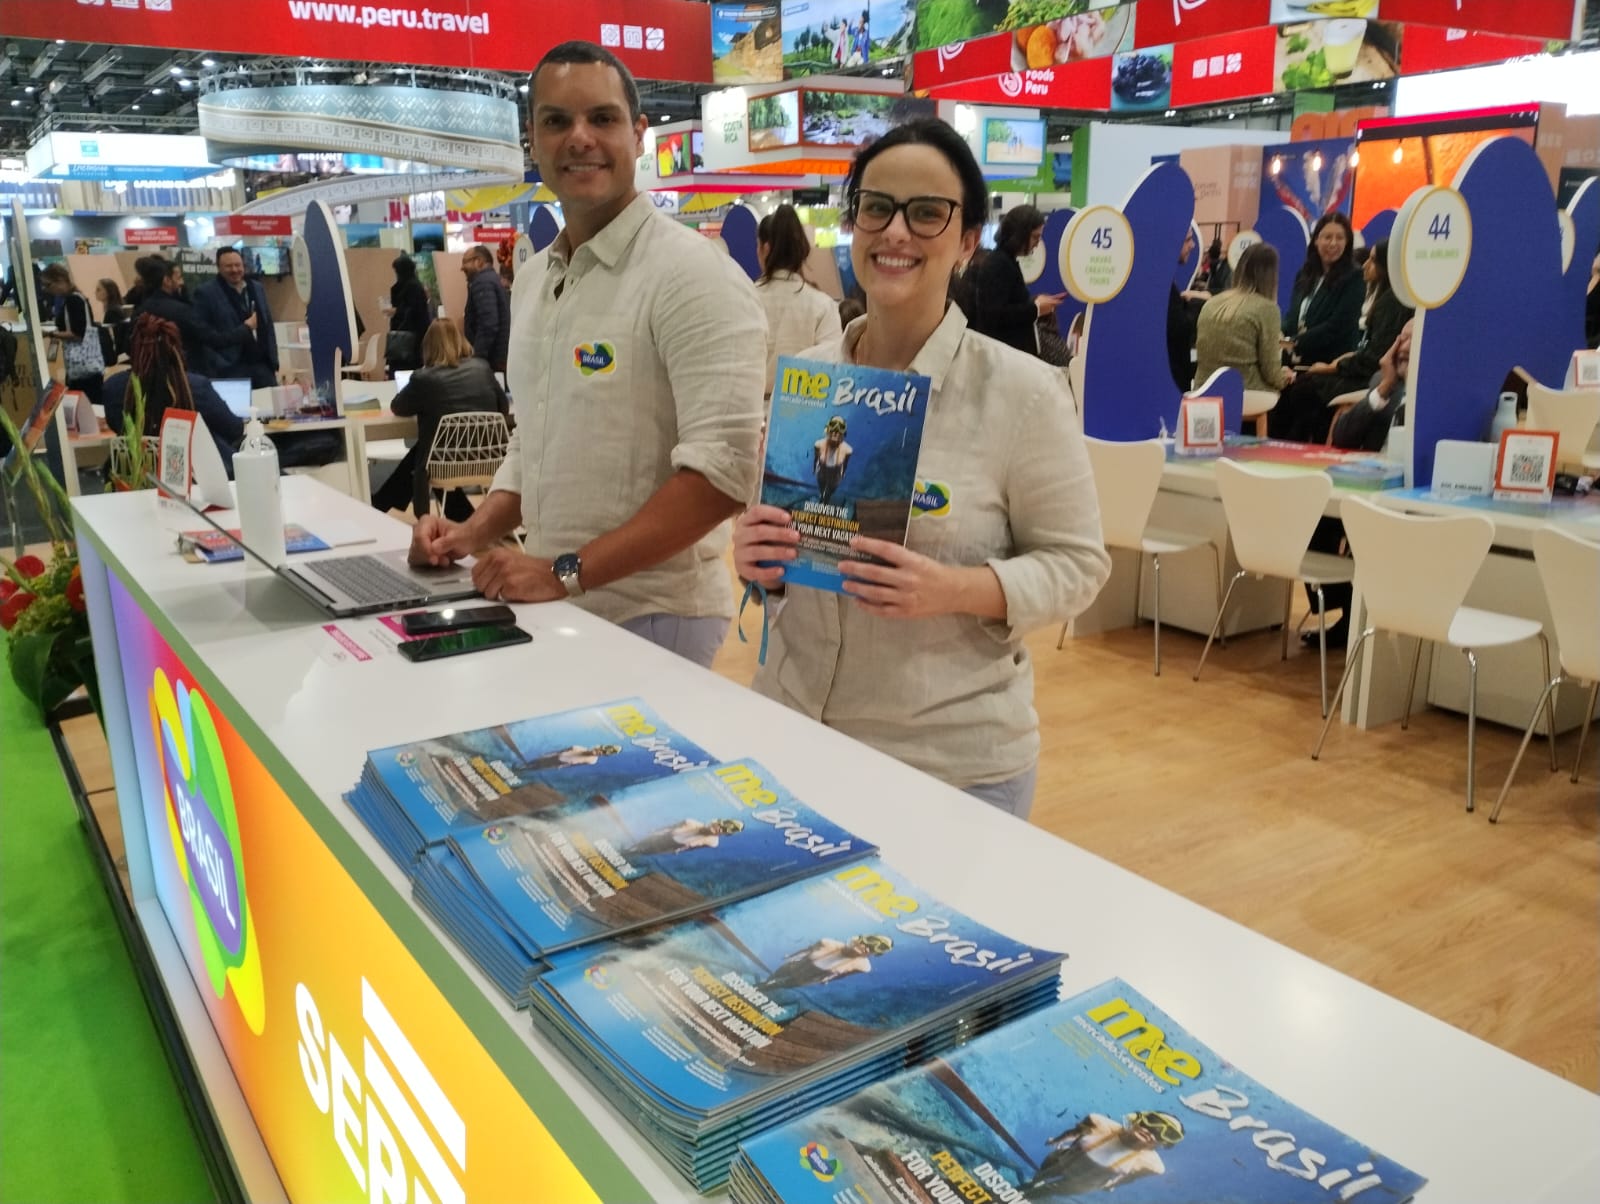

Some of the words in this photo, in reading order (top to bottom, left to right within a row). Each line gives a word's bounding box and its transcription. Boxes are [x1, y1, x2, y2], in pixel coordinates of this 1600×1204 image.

[288, 1, 490, 34] www.peru.travel
[1091, 227, 1113, 249] 45
[1428, 213, 1450, 240] 44
[832, 376, 917, 416] Brasil
[803, 501, 835, 516] DISCOVER
[836, 507, 849, 519] THE
[813, 524, 831, 539] NEXT
[752, 807, 851, 857] Brasil
[176, 783, 237, 931] BRASIL
[896, 915, 1034, 974] Brasil
[700, 999, 732, 1020] NEXT
[761, 1000, 786, 1018] THE
[1086, 997, 1203, 1087] m&e
[1178, 1084, 1382, 1201] Brasil
[901, 1150, 933, 1180] FOR
[931, 1151, 992, 1204] PERFECT
